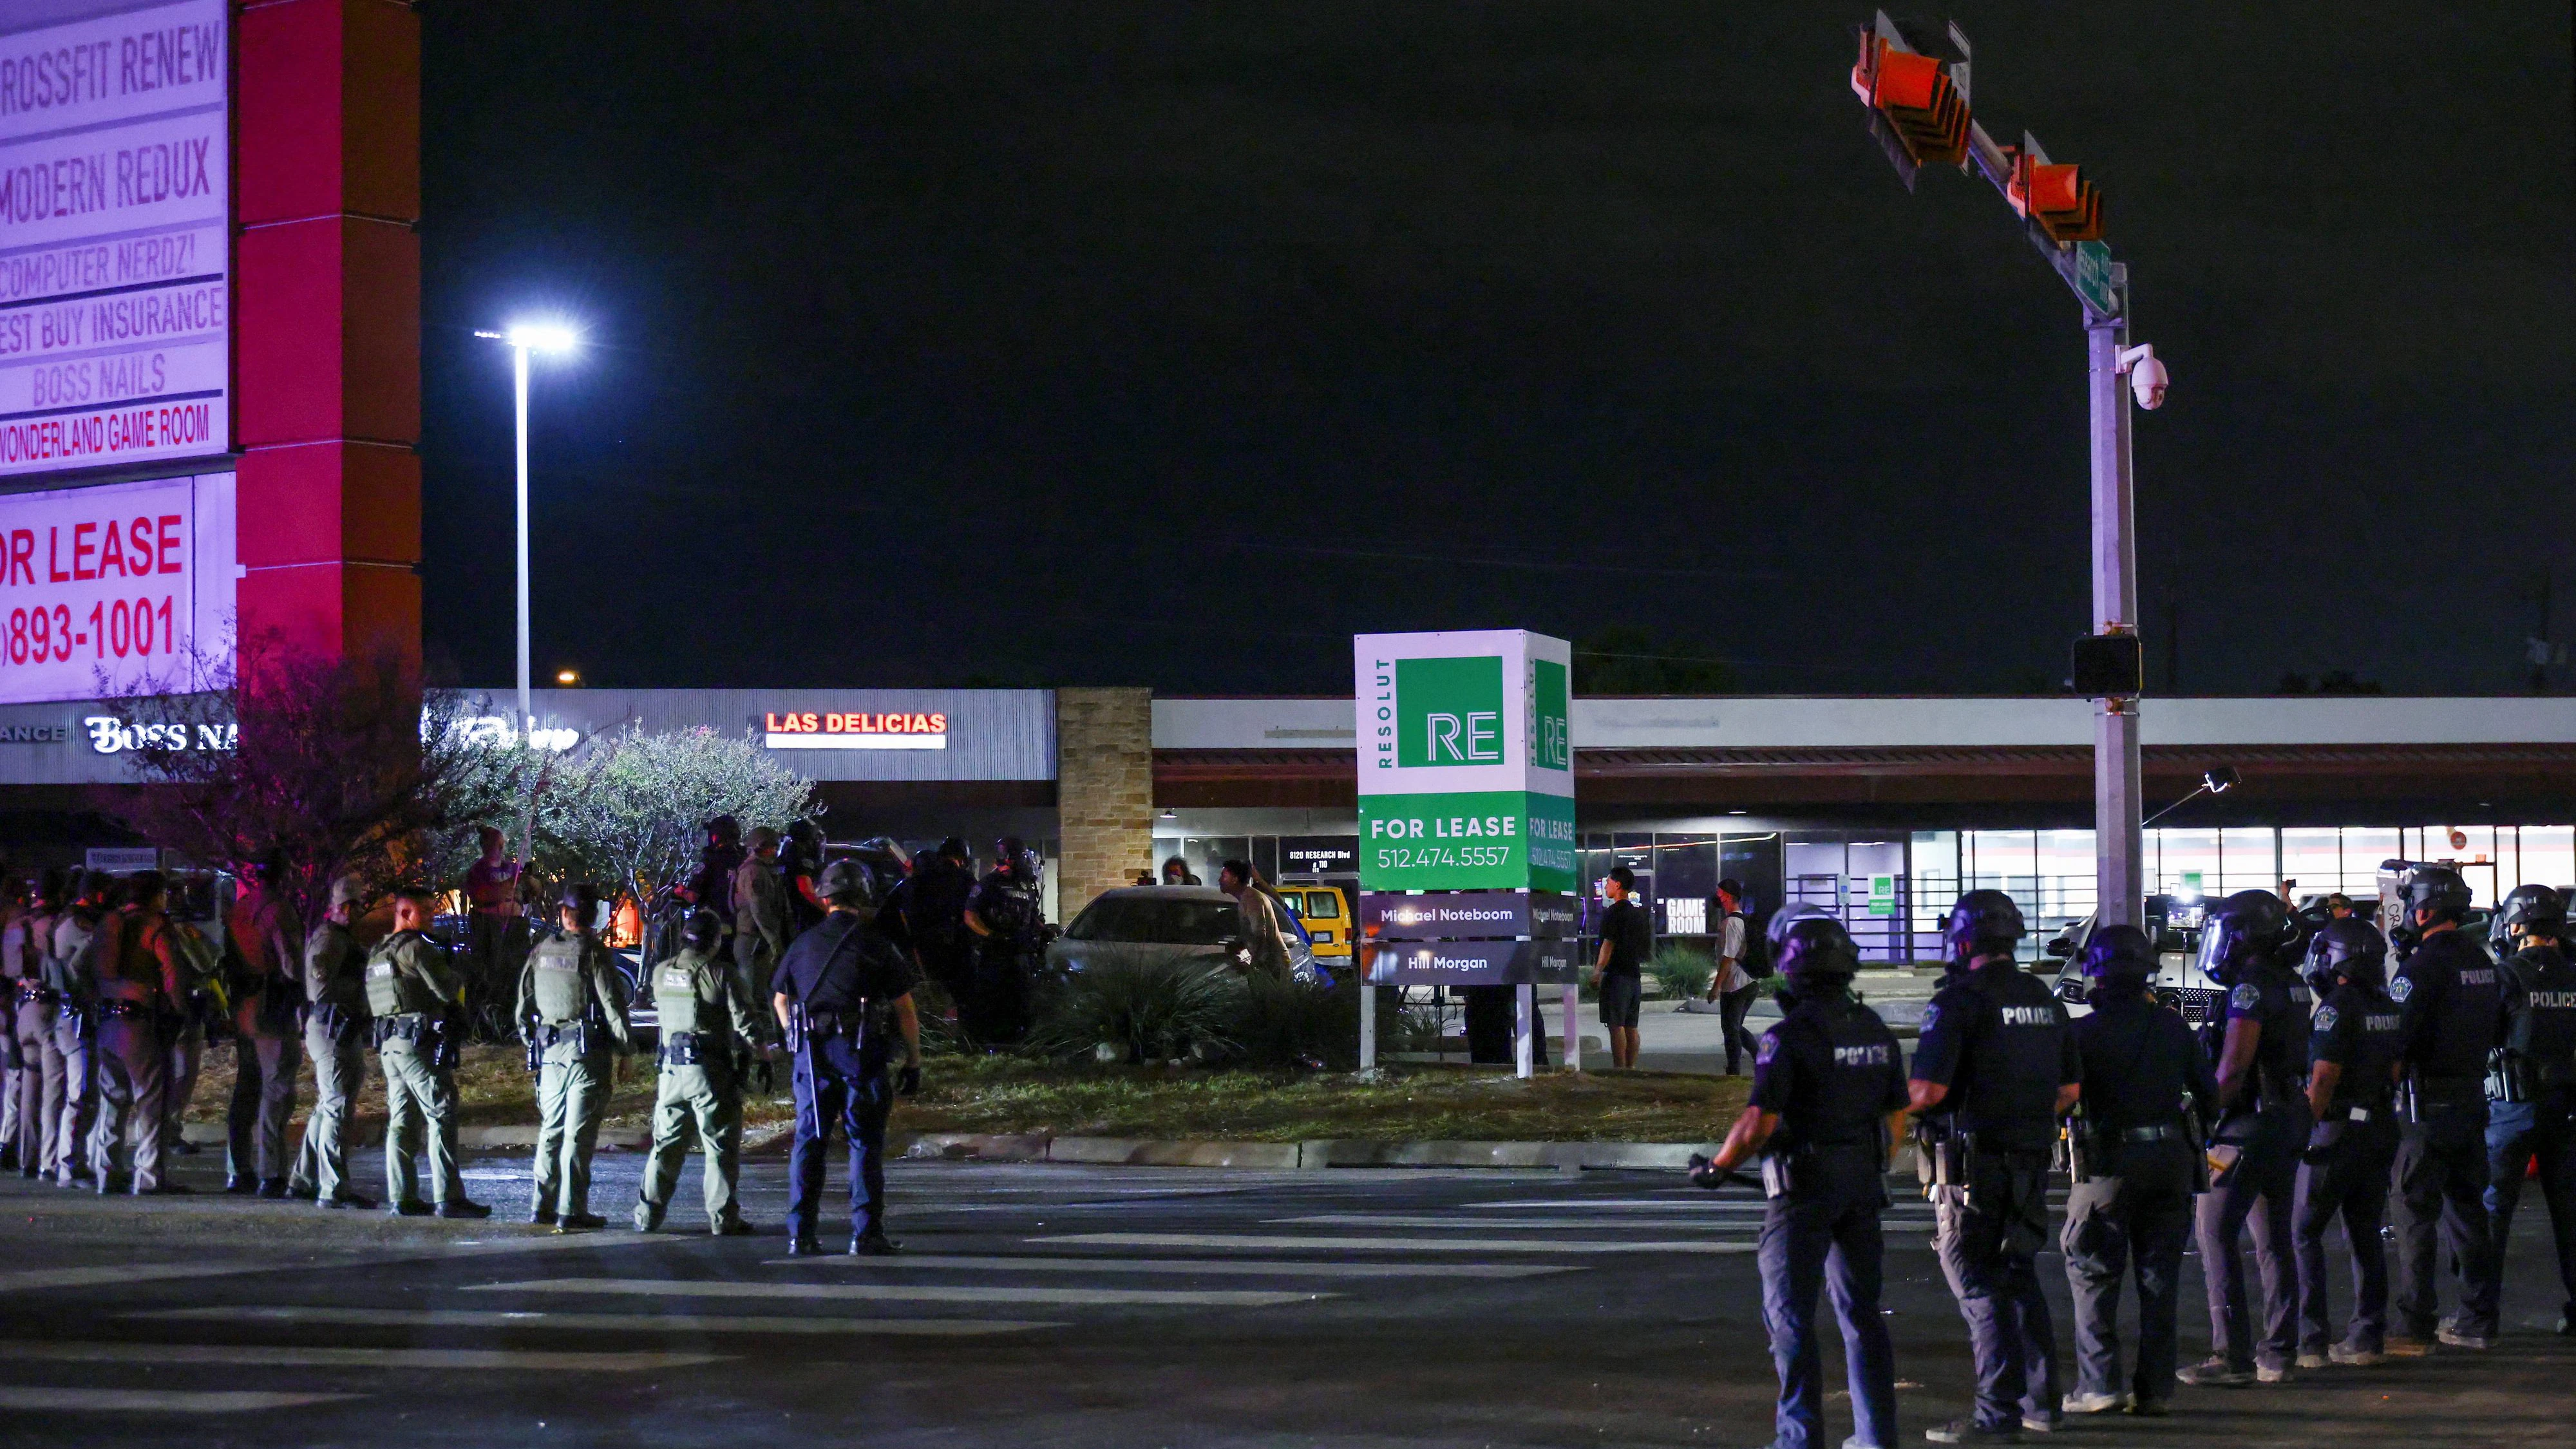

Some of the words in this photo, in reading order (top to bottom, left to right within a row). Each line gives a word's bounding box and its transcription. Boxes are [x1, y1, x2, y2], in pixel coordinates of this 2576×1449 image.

[121, 20, 221, 96] RENEW
[117, 137, 211, 207] REDUX
[0, 245, 108, 297] COMPUTER
[118, 233, 195, 281] NERDZ!
[42, 306, 84, 349] BUY
[93, 287, 223, 342] INSURANCE
[33, 361, 91, 407] BOSS
[100, 353, 166, 400] NAILS
[108, 410, 154, 446] GAME
[160, 404, 209, 442] ROOM
[50, 515, 182, 583] LEASE
[766, 713, 819, 733] LAS
[826, 713, 946, 734] DELICIAS
[1376, 659, 1392, 768] RESOLUT
[1427, 712, 1499, 761] RE
[1544, 715, 1567, 765] RE
[1372, 819, 1424, 839] FOR
[1436, 817, 1515, 838] LEASE
[1530, 817, 1546, 838] FOR
[1548, 819, 1573, 841] LEASE
[1289, 851, 1304, 860] 8120
[1305, 851, 1336, 860] RESEARCH
[1337, 850, 1350, 859] Blvd
[1378, 847, 1509, 868] 512.474.5557
[1381, 908, 1436, 922] Michael
[1440, 908, 1513, 921] Noteboom
[1667, 898, 1706, 917] GAME
[1668, 916, 1707, 934] ROOM
[1408, 956, 1430, 969] Hill
[1434, 956, 1488, 972] Morgan
